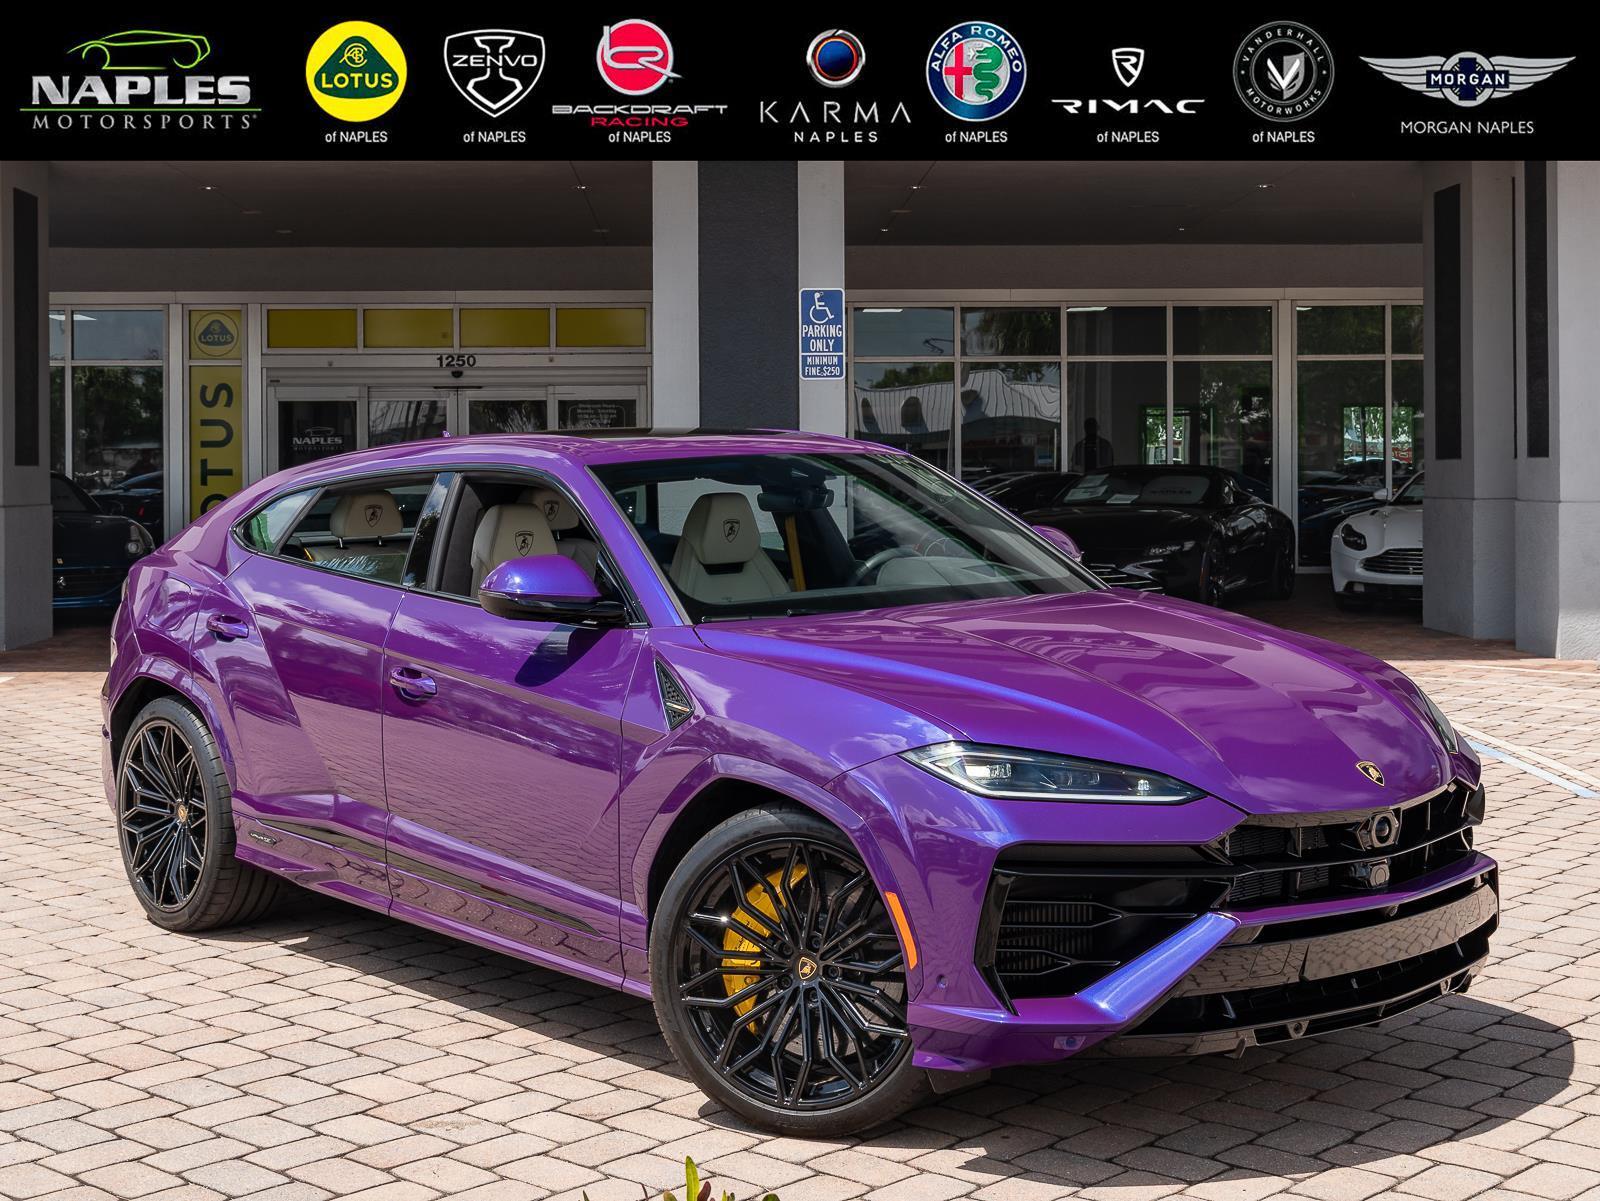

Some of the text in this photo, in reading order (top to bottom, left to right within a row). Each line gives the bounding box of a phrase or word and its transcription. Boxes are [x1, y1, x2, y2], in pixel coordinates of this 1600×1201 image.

[802, 325, 842, 337] PARKING
[201, 334, 232, 342] LOTUS
[810, 339, 835, 351] ONLY
[437, 355, 477, 367] 1250
[807, 356, 838, 365] MINIMUM
[805, 367, 821, 376] FINE
[292, 437, 343, 445] NAPLES
